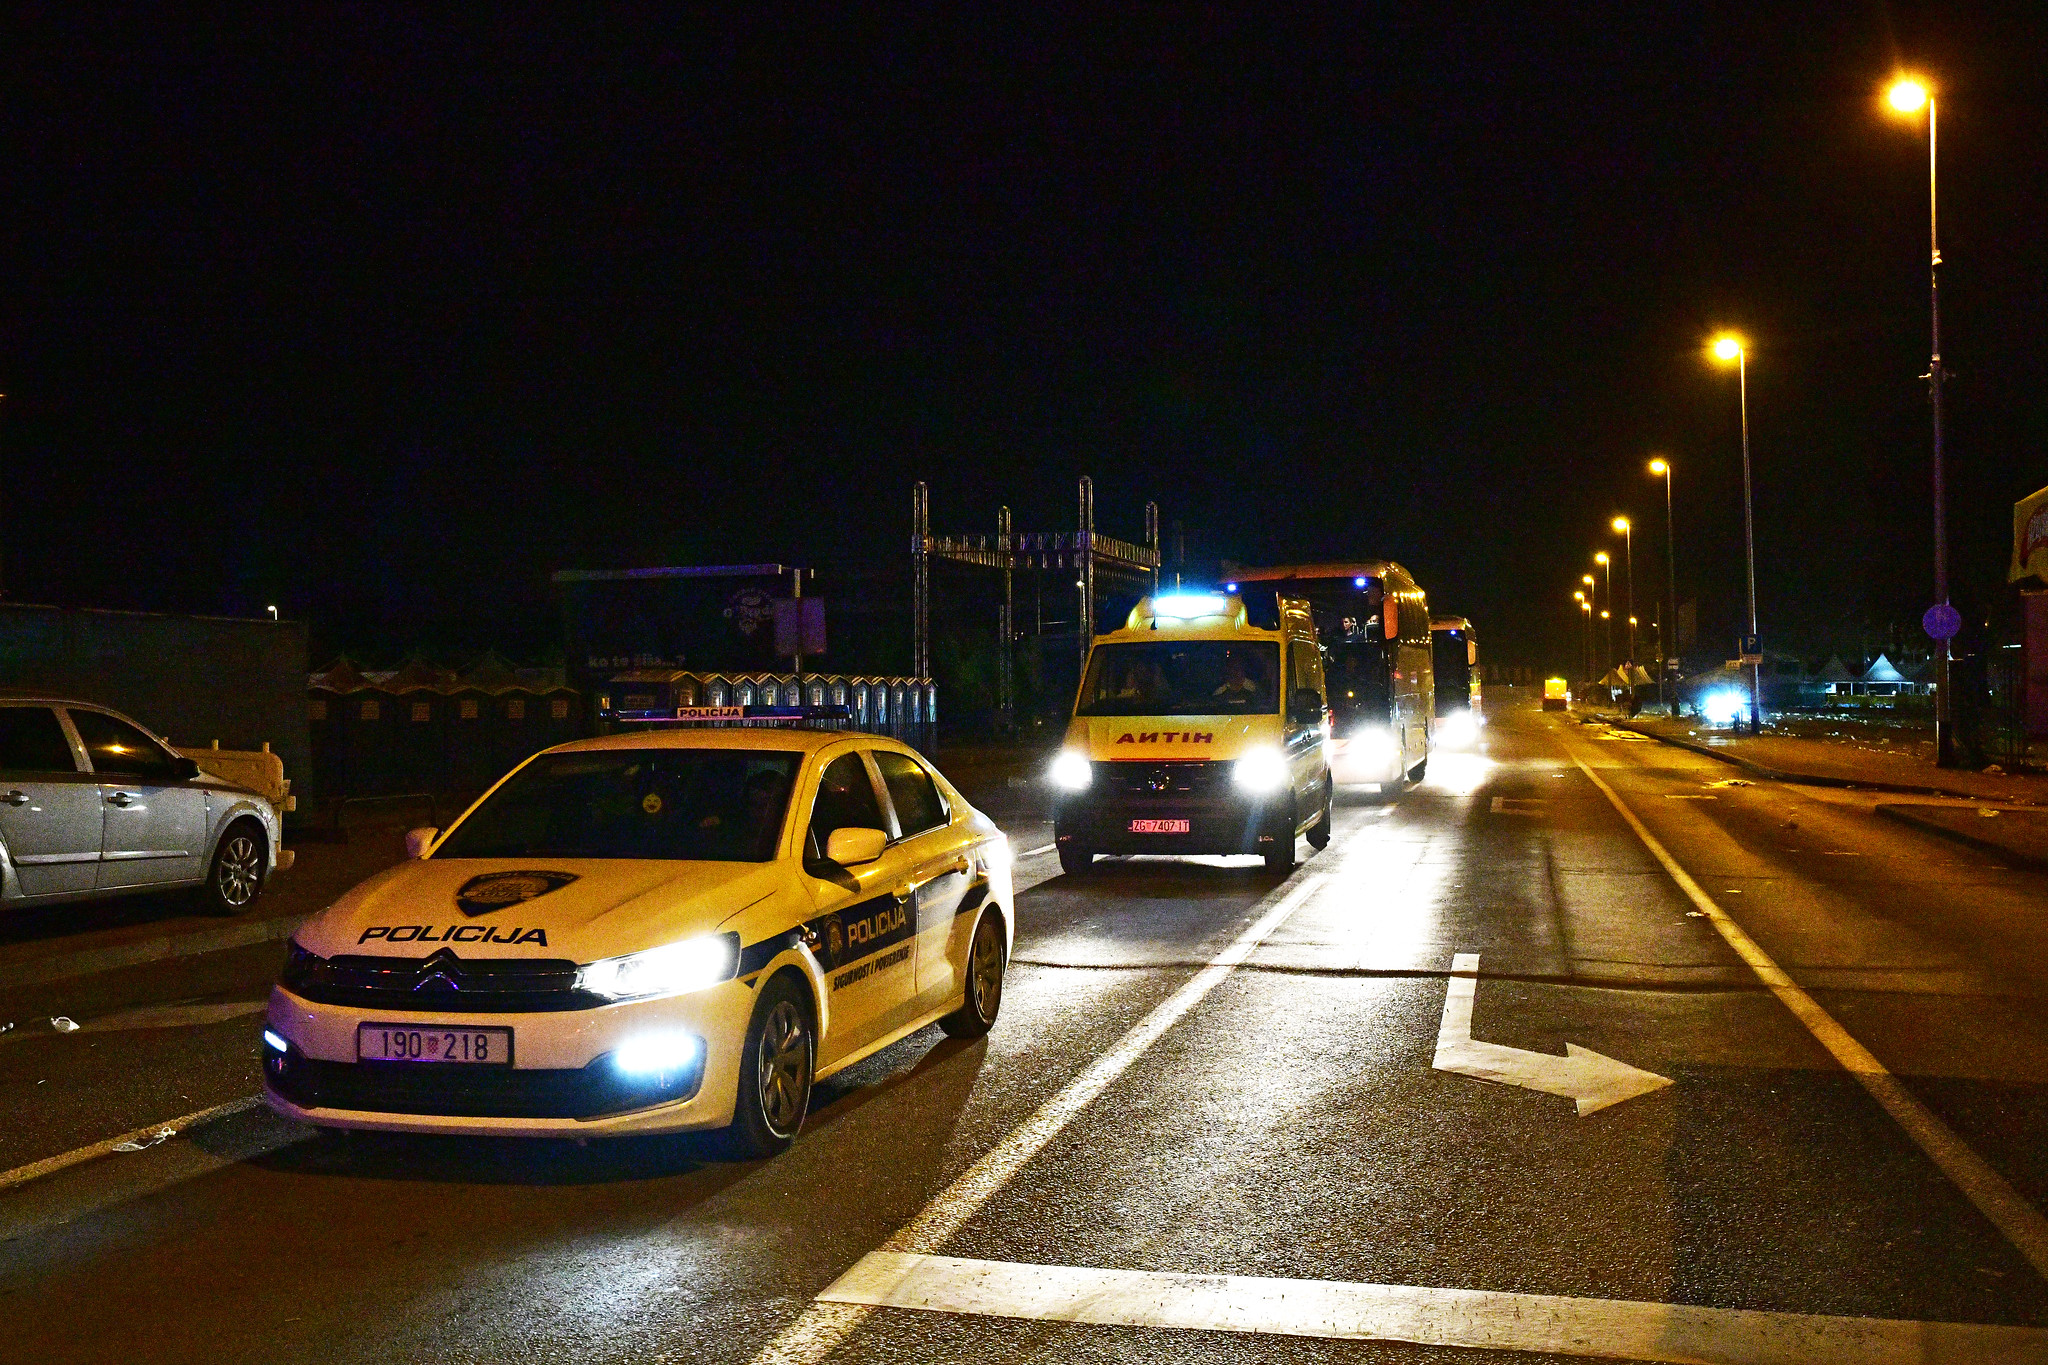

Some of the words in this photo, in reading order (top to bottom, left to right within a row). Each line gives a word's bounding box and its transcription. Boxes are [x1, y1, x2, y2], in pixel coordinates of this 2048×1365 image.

[679, 708, 740, 717] POLICIJA
[1133, 821, 1146, 831] ZG
[1152, 821, 1175, 831] 7407
[358, 926, 548, 947] POLICIJA
[848, 905, 906, 948] POLICIJA
[382, 1031, 421, 1058] 190
[443, 1033, 488, 1060] 218
